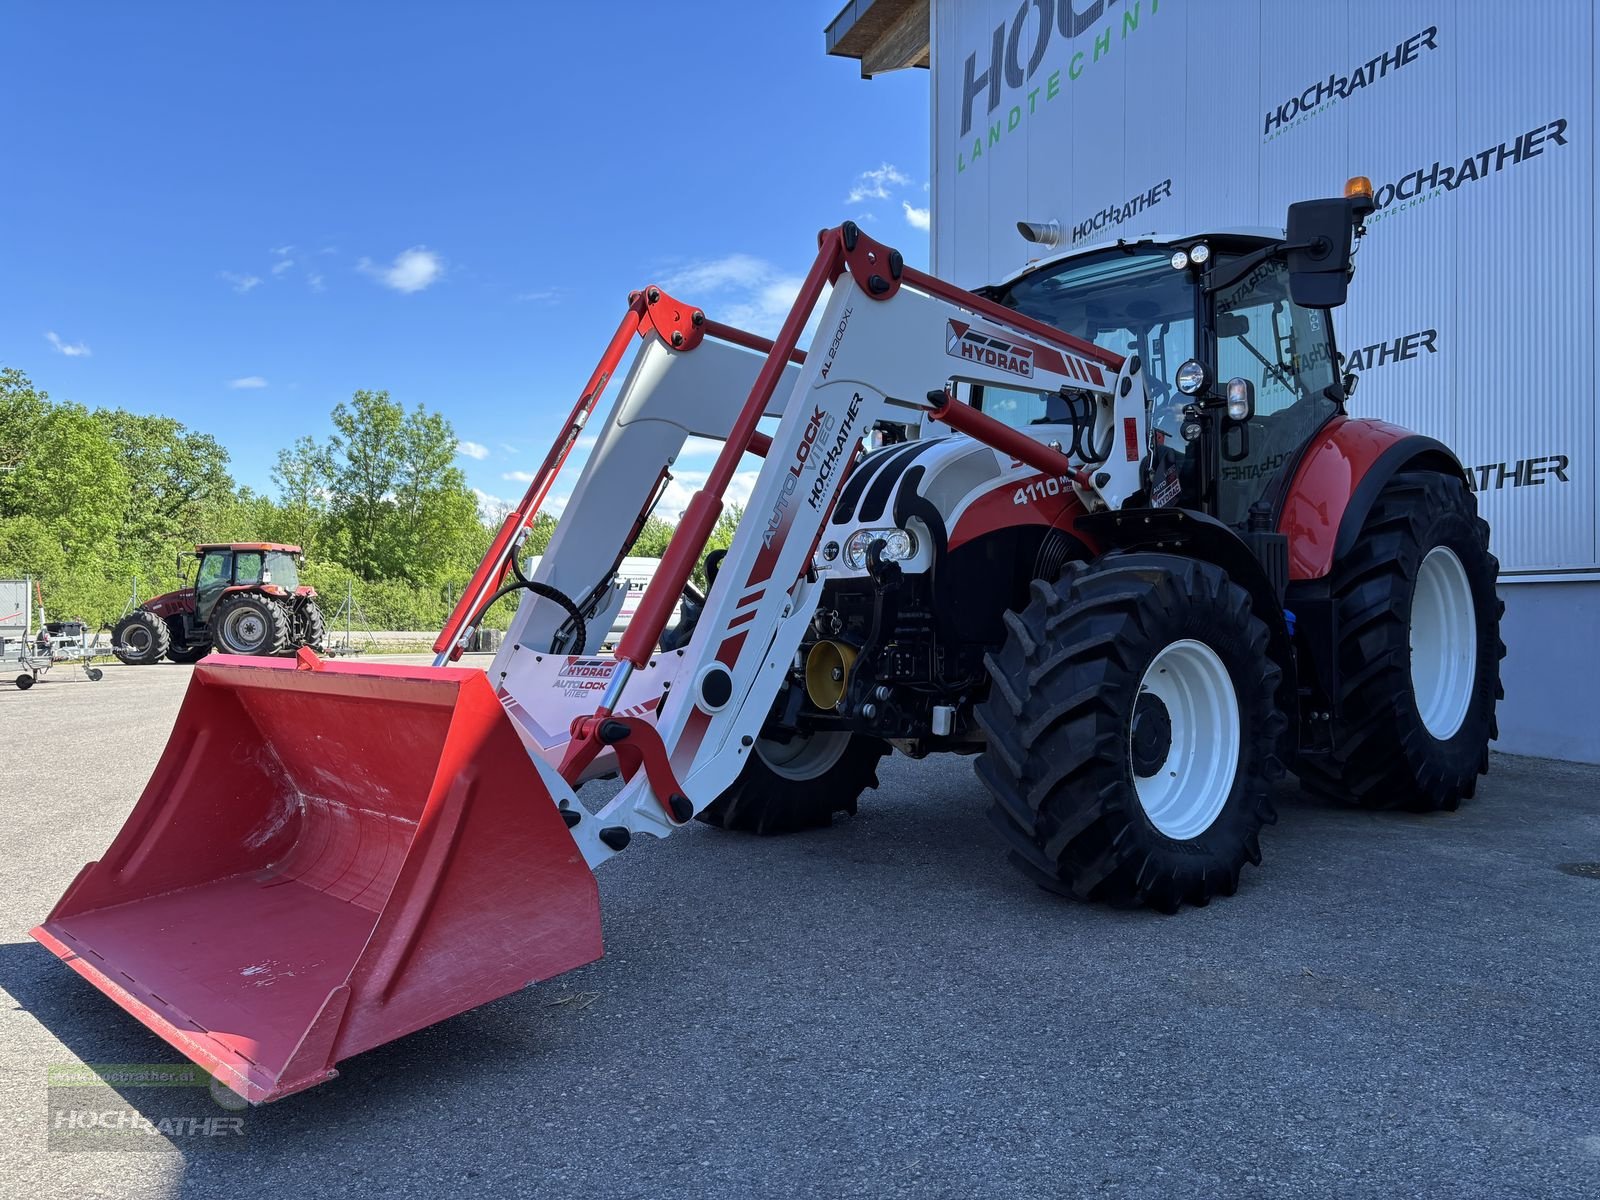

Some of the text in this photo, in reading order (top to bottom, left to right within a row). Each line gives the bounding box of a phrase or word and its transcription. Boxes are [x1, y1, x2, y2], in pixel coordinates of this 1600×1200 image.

[1264, 25, 1438, 136] HOCHRATHER
[1263, 97, 1338, 144] LANDTECHNIK
[1373, 117, 1568, 211] OCHRATHER
[1072, 178, 1172, 244] HOCHRATHER
[1366, 188, 1442, 225] NDTECHNIK
[821, 306, 854, 380] AL 2300XL
[961, 341, 1031, 376] HYDRAC
[808, 392, 864, 509] HOCHRATHER
[1013, 477, 1060, 505] 4110
[552, 679, 608, 691] AUTOLOCK
[567, 666, 612, 677] HYDRAC
